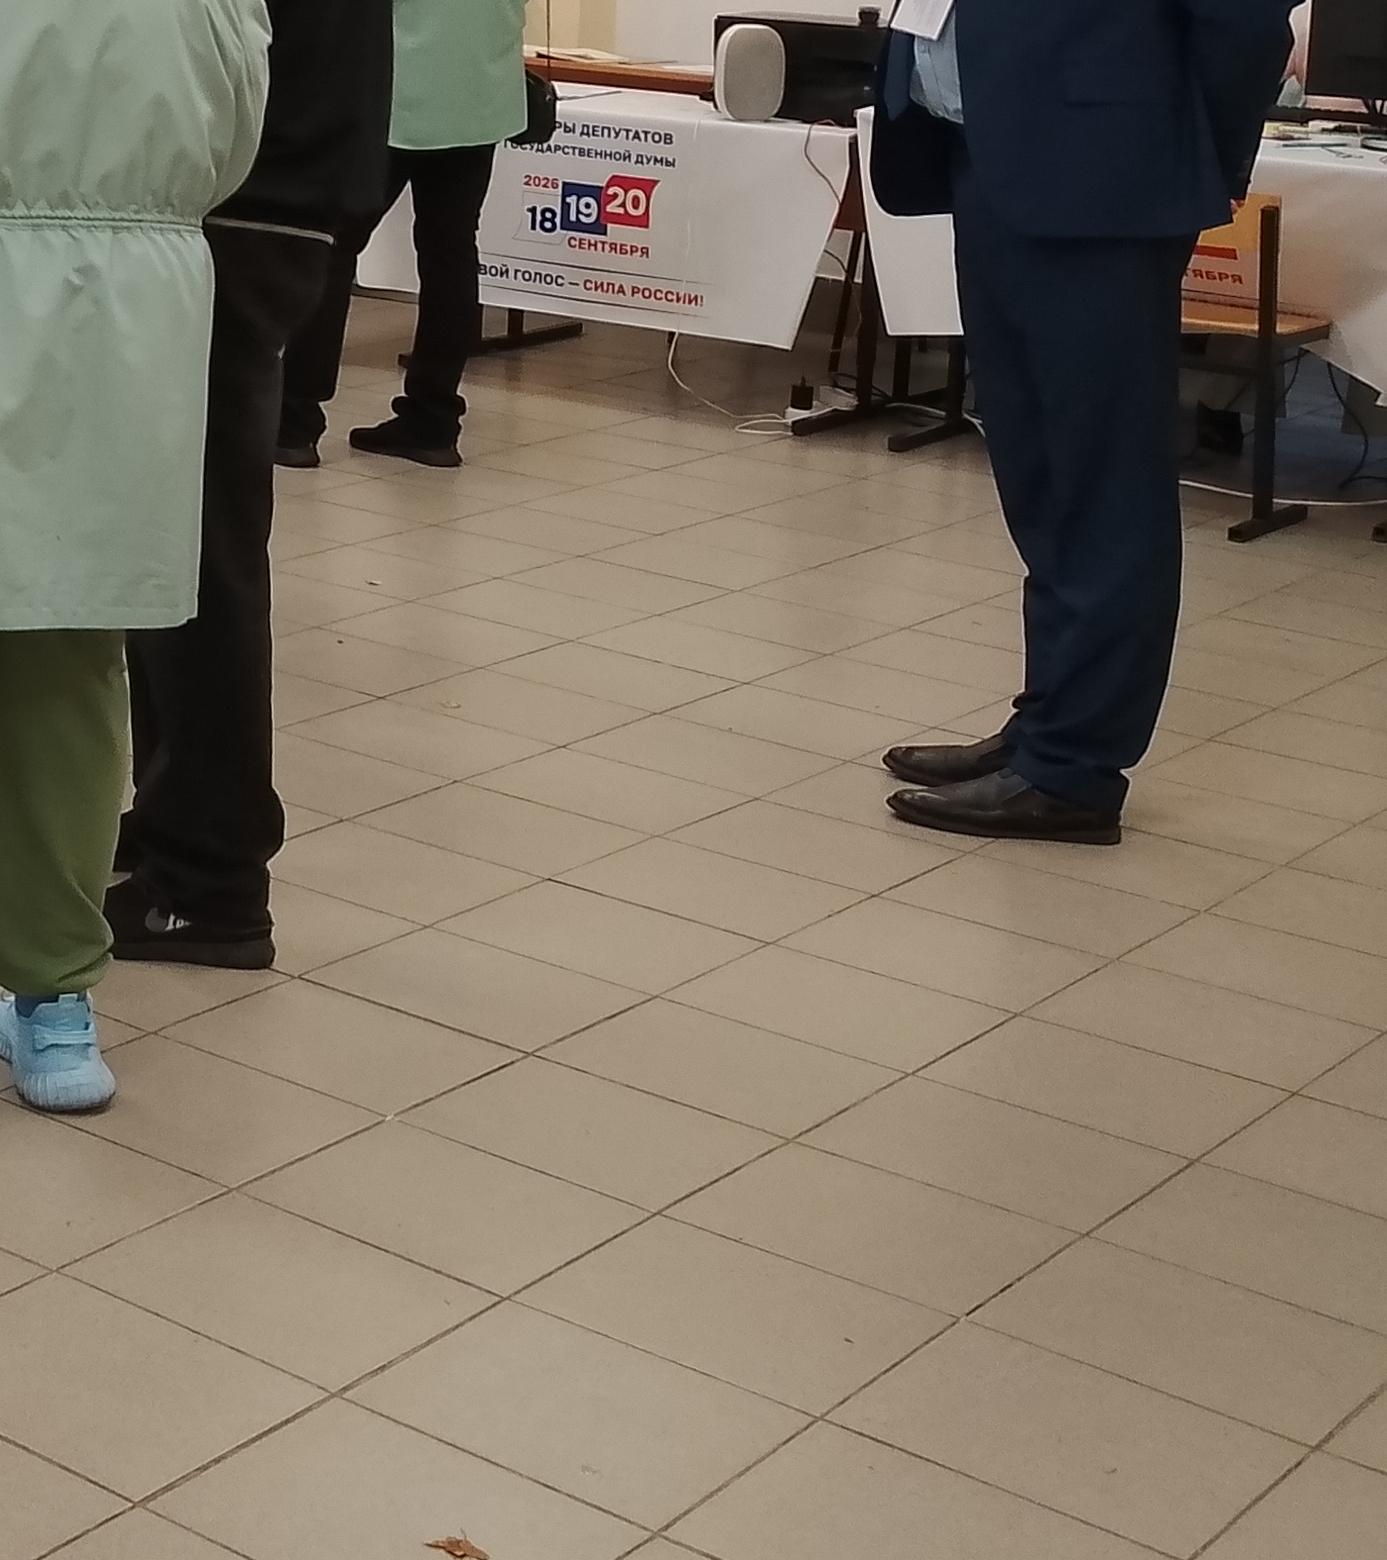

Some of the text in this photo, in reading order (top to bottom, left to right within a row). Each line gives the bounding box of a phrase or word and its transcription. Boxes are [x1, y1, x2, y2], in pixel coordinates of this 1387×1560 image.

[580, 125, 673, 145] ДЕПУТАТОВ
[635, 152, 676, 168] ДУМЫ
[523, 175, 559, 189] 2026
[527, 187, 646, 233] 18 19 20
[568, 237, 650, 258] СЕНТЯБРЯ
[479, 264, 509, 279] ВОЙ
[514, 269, 564, 287] ГОЛОС
[584, 280, 626, 296] СИЛА
[631, 284, 703, 306] РОССИИ!
[1186, 268, 1243, 284] ЯБРЯ
